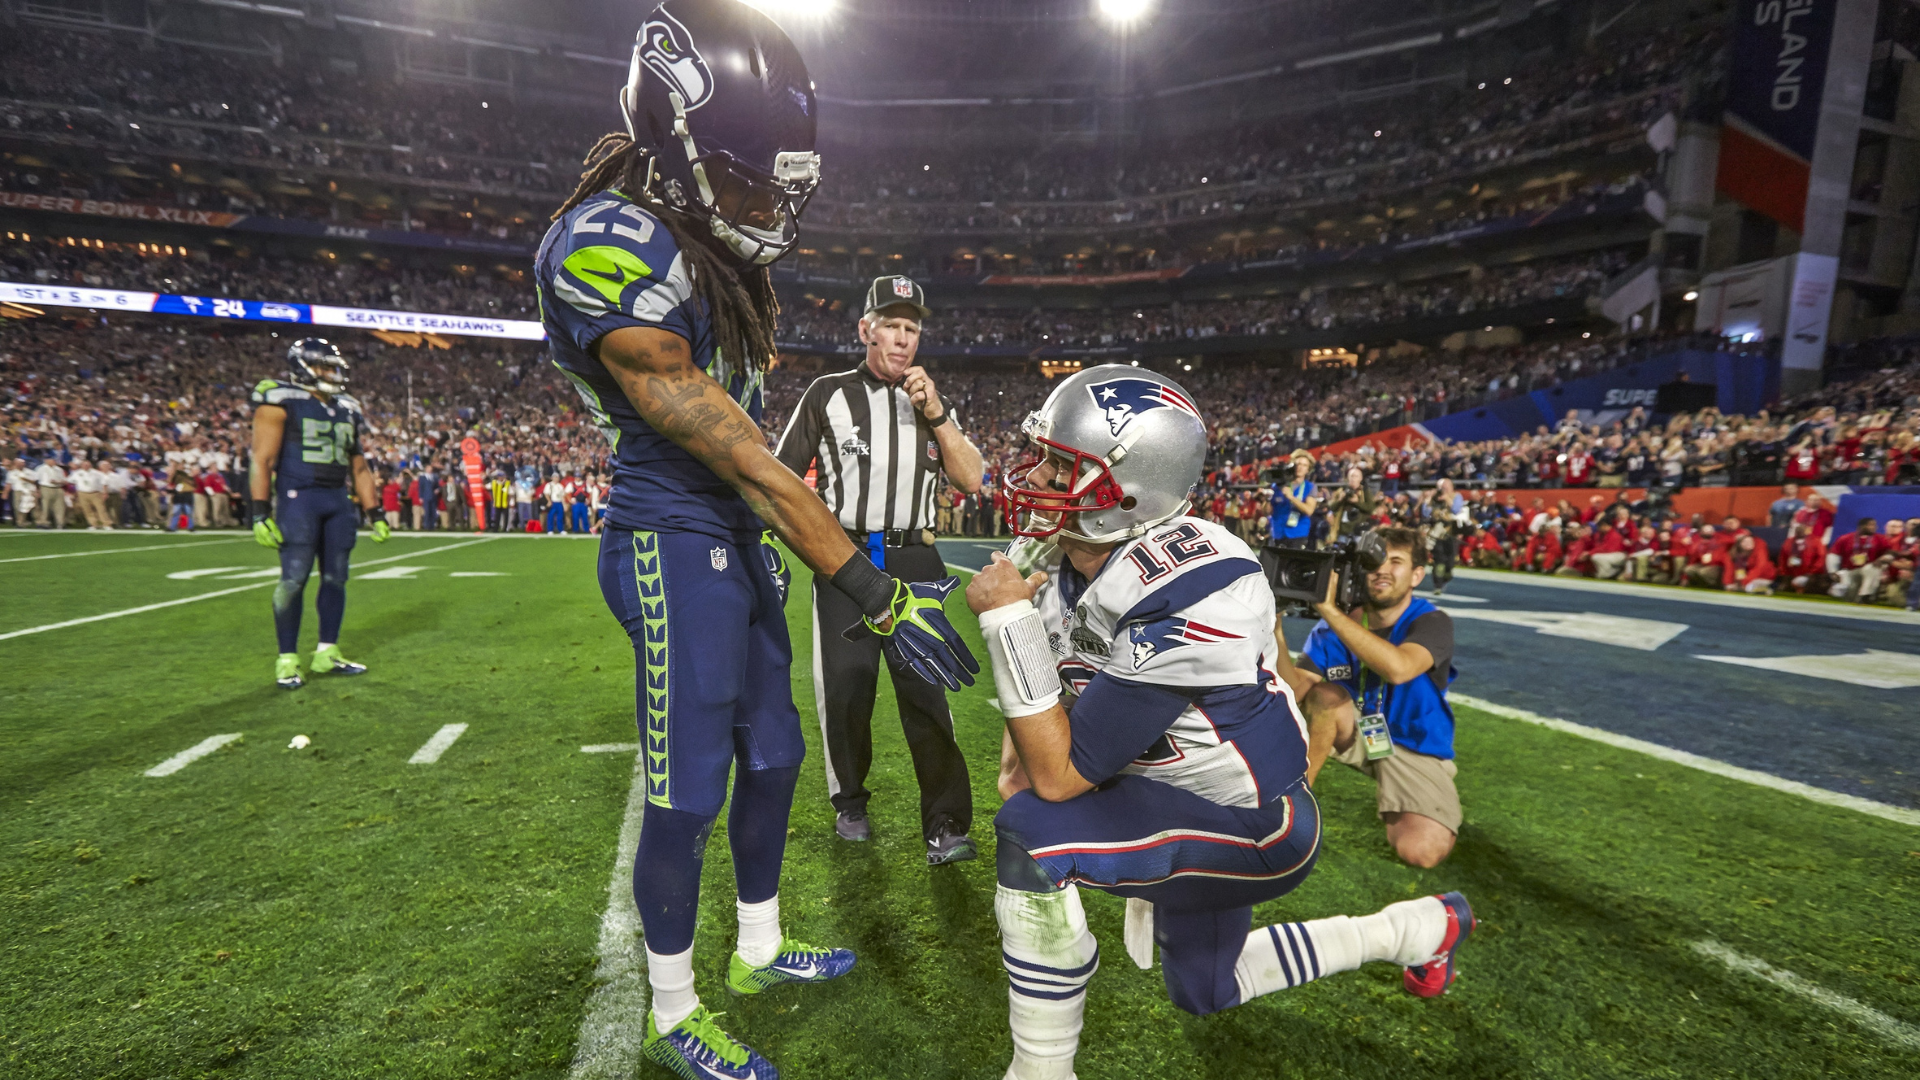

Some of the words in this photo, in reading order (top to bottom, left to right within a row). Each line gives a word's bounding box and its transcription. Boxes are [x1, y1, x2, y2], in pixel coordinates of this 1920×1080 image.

[0, 192, 74, 213] UPER
[80, 199, 150, 219] BOWL
[155, 206, 213, 225] XLIX
[572, 200, 656, 244] 25
[16, 288, 46, 300] 1ST
[69, 291, 81, 303] 5
[115, 294, 128, 306] 6
[212, 299, 246, 318] 24
[346, 311, 415, 326] SEATTLE
[420, 317, 505, 333] SEAHAWKS
[841, 446, 870, 456] XLIX
[1122, 522, 1219, 586] 12
[1329, 668, 1351, 679] SDS
